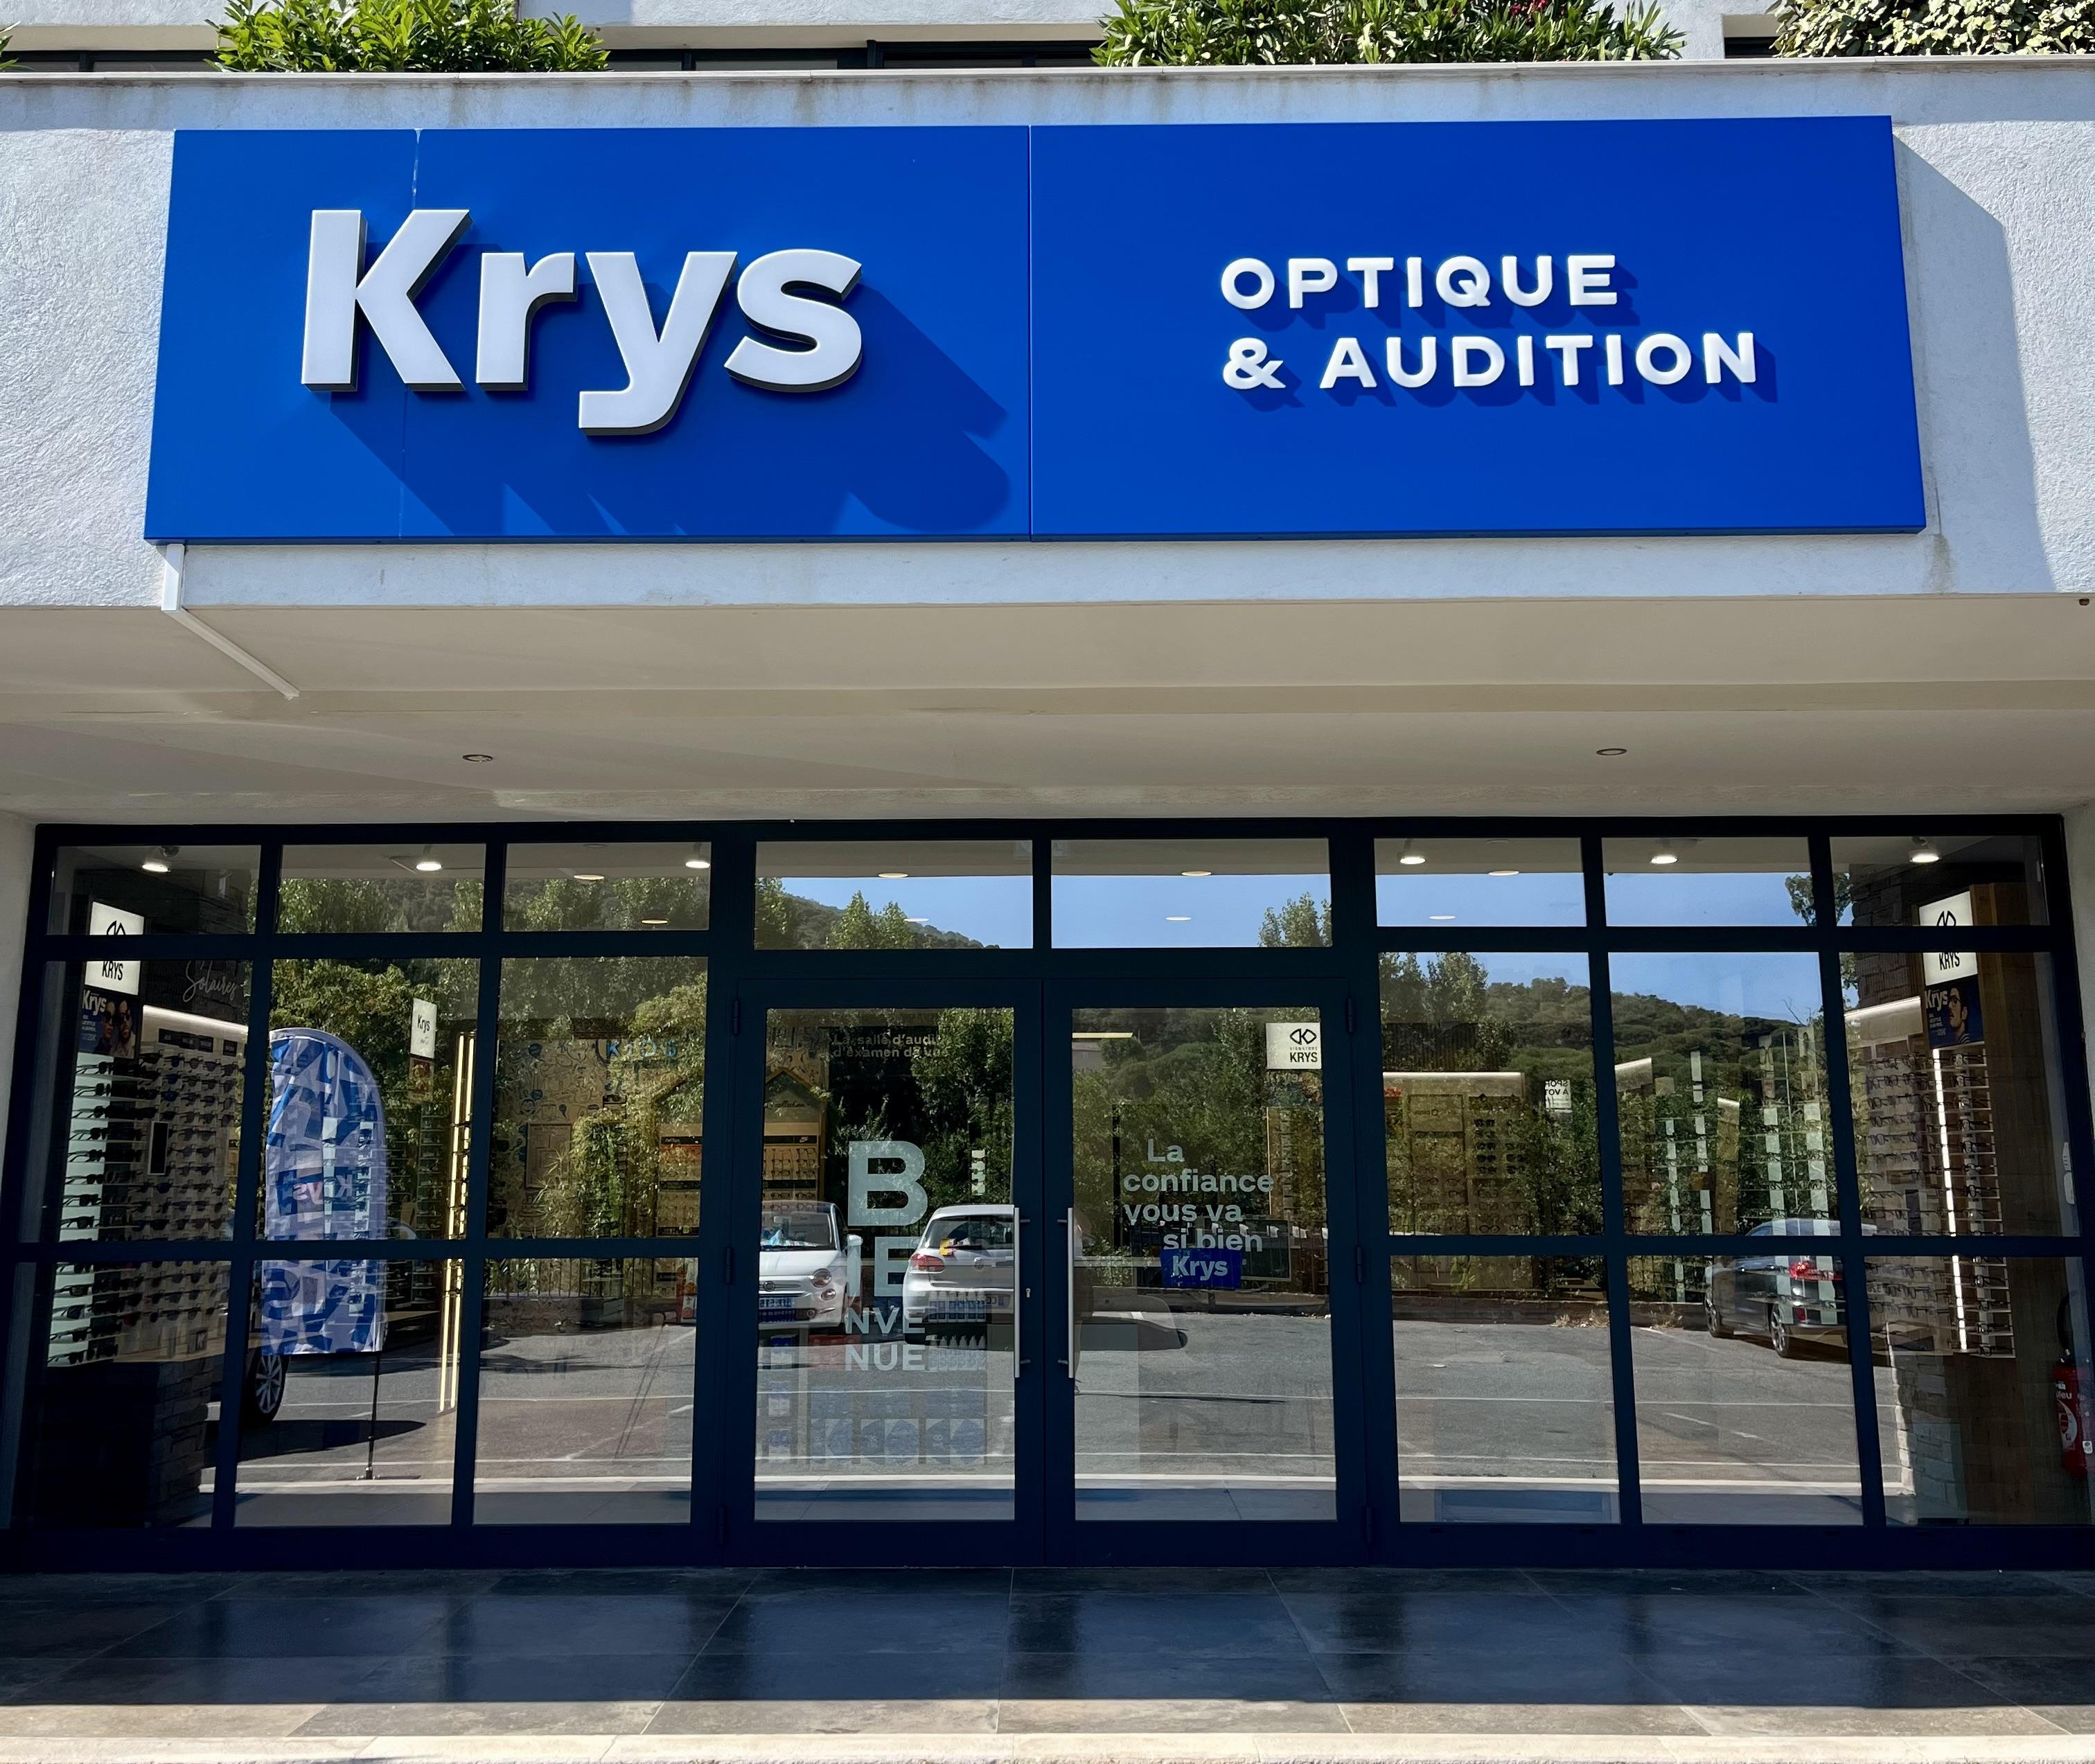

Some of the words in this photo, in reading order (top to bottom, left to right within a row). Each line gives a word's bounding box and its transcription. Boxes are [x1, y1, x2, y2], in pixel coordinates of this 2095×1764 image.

[1221, 254, 1618, 310] OPTIQUE
[301, 209, 863, 435] Krys
[1222, 337, 1286, 389] &
[1319, 333, 1756, 389] AUDITION
[102, 960, 123, 981] KRYS
[1939, 952, 1961, 971] KRYS
[82, 989, 107, 1015] Krys
[1924, 989, 1949, 1012] Krys
[417, 1014, 430, 1033] Krys
[1289, 1052, 1318, 1063] KRYS
[1147, 1138, 1185, 1163] La
[847, 1140, 928, 1226] B
[1123, 1168, 1275, 1192] confiance
[1124, 1204, 1197, 1222] vous
[1205, 1203, 1244, 1222] va
[1163, 1228, 1189, 1251] si
[1196, 1227, 1263, 1252] bien
[1172, 1255, 1228, 1281] Krys
[845, 1307, 926, 1334] NVE
[845, 1344, 926, 1371] NUE
